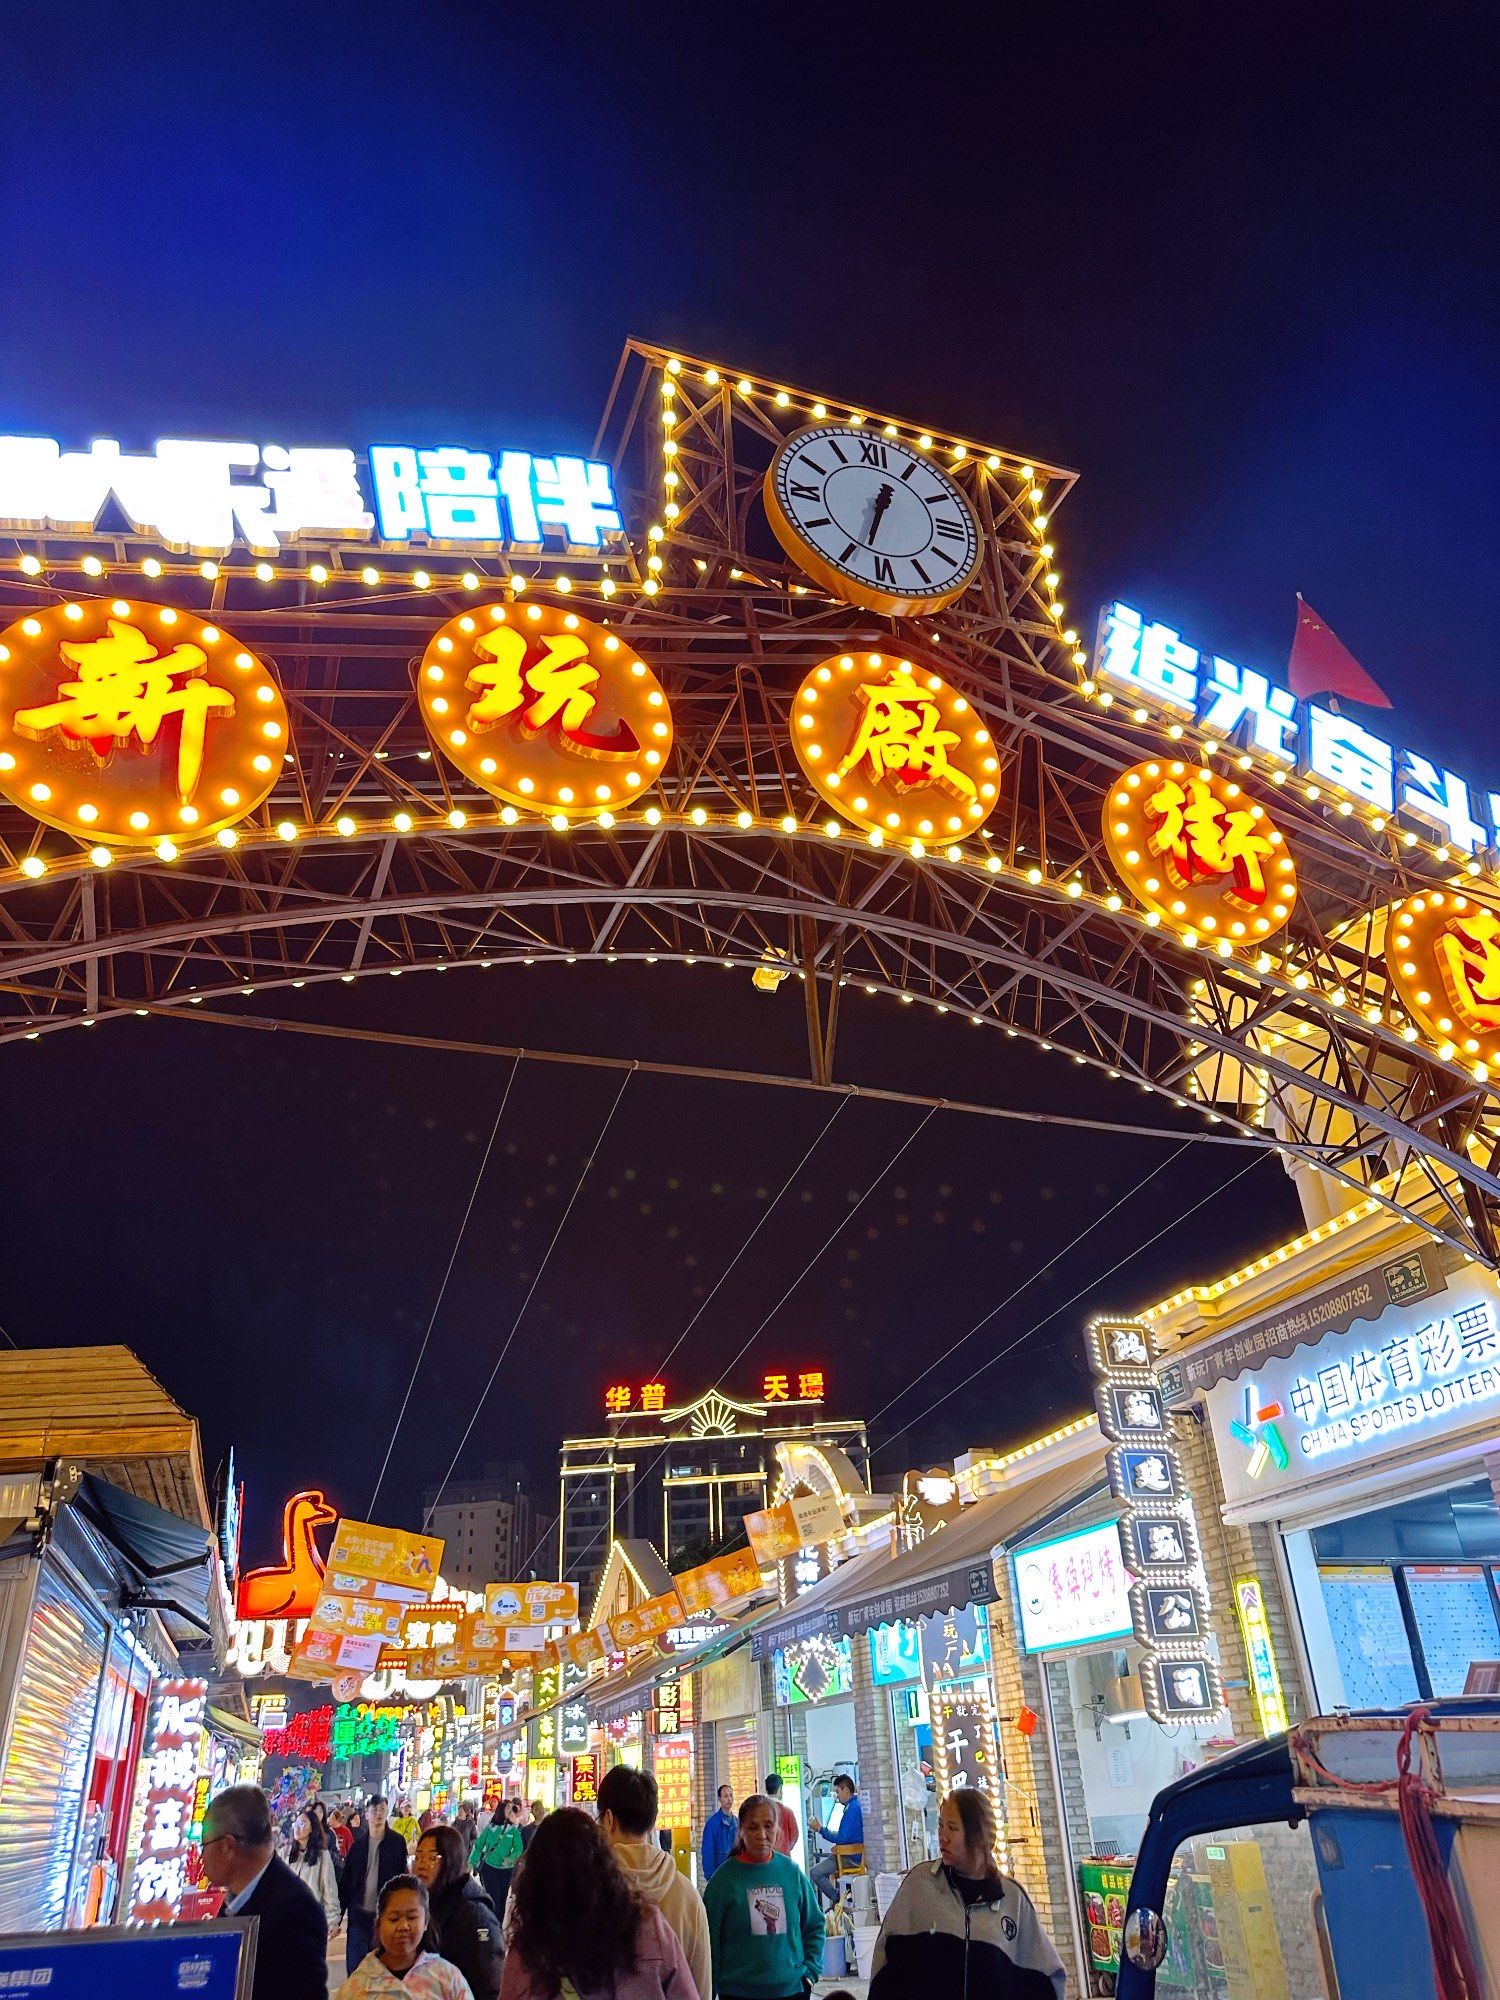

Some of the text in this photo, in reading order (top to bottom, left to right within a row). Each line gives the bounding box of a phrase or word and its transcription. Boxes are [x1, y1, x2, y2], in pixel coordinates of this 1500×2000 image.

[858, 439, 888, 470] XII
[1098, 599, 1500, 860] 追光奋斗
[14, 618, 1276, 912] 新 玩 廠 街
[1289, 1301, 1497, 1422] 中国体育彩票
[605, 1372, 825, 1412] 华普 天璟
[1350, 1397, 1418, 1437] SPORTS
[0, 1967, 53, 1988] 集团
